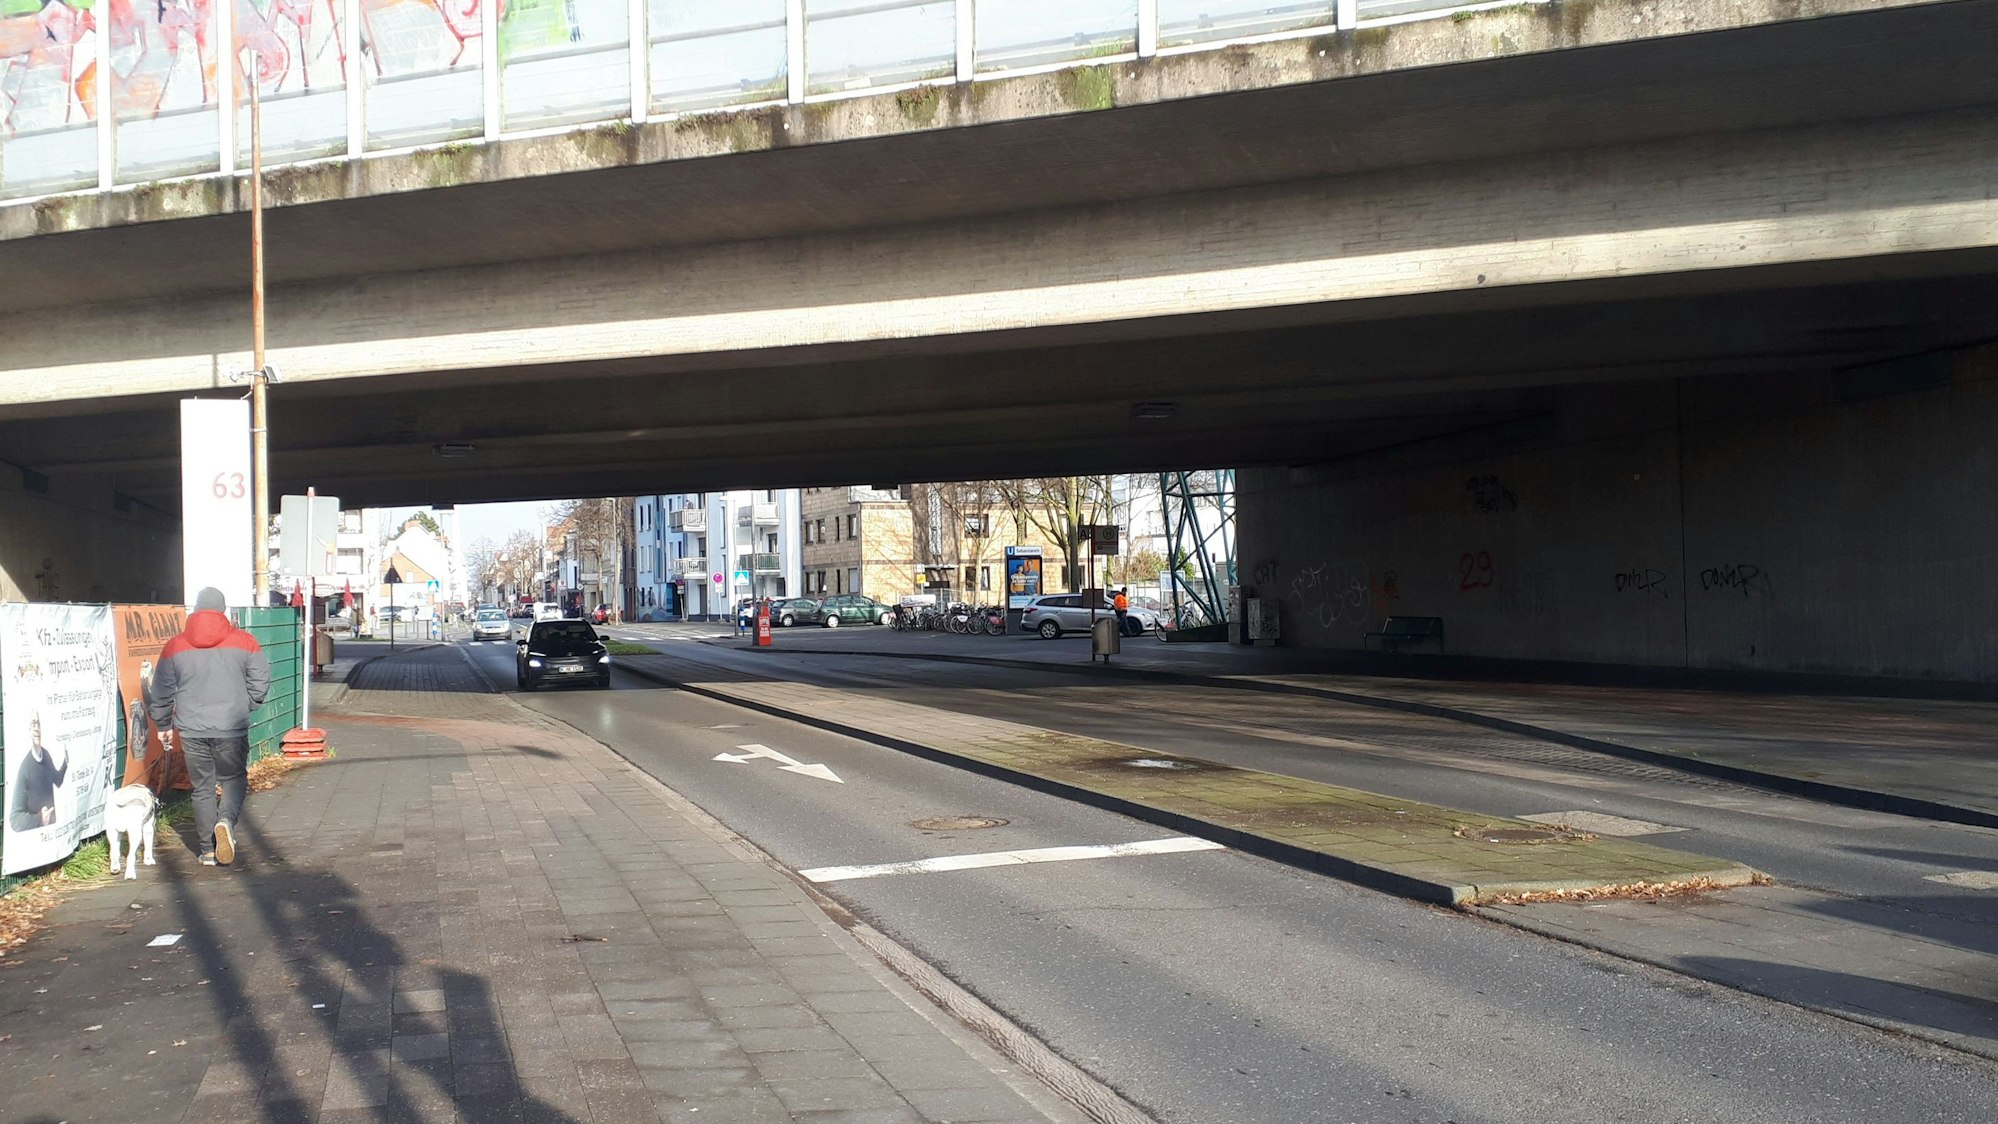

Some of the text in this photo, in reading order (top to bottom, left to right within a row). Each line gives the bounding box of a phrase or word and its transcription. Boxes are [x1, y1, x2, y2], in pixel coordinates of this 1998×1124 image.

[212, 472, 245, 499] 63
[1458, 550, 1493, 590] 29
[125, 611, 150, 643] MR.
